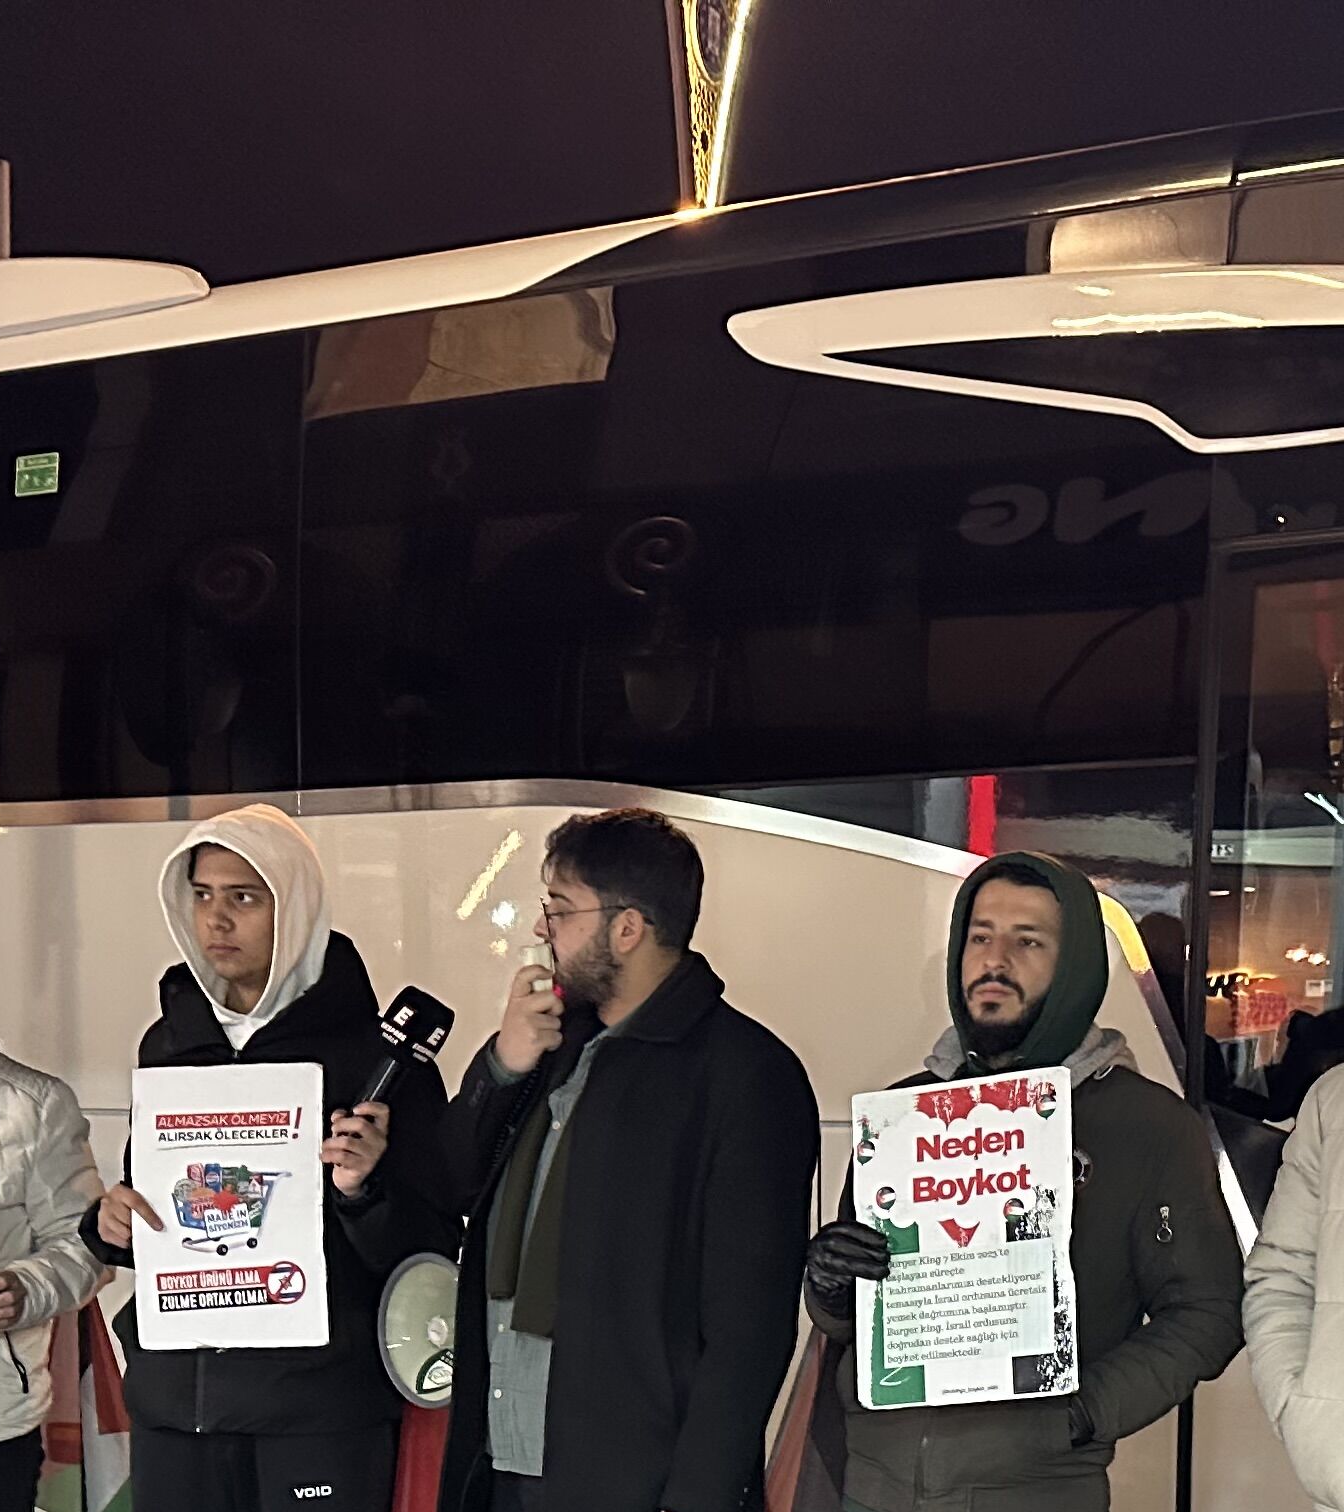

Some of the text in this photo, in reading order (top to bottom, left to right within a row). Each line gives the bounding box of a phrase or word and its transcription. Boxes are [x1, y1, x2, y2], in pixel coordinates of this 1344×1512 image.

[393, 1005, 414, 1026] E
[426, 1026, 446, 1046] E
[157, 1114, 229, 1128] ALMAZSAK
[158, 1127, 289, 1142] ALIRSAK ÖLECEKLER
[916, 1126, 1025, 1162] Neden
[912, 1164, 1031, 1206] Boykot
[919, 1255, 942, 1268] King
[949, 1251, 976, 1262] Ekim
[159, 1274, 199, 1290] BOYKOT
[161, 1294, 198, 1311] ZULME
[198, 1292, 234, 1308] ORTAK
[887, 1327, 919, 1340] Burger
[294, 1485, 333, 1499] VOID
